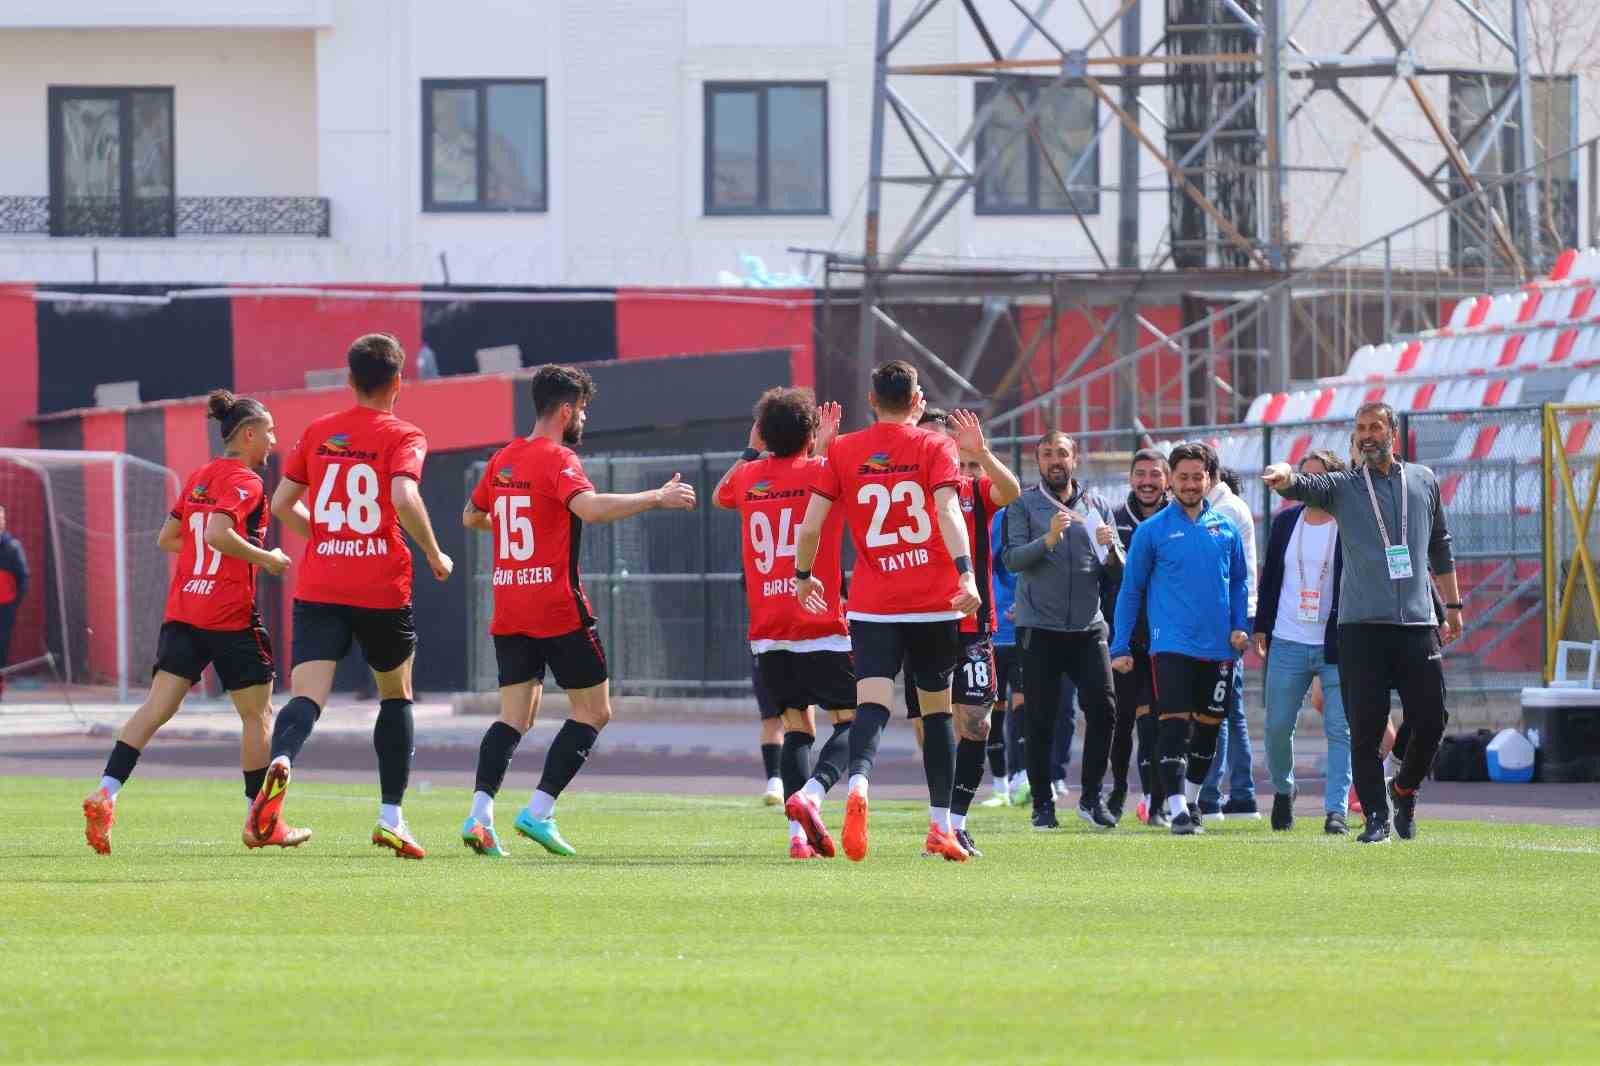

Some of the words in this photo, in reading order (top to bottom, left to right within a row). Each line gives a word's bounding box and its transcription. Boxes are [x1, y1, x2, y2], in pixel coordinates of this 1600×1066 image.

[314, 463, 382, 535] 48
[857, 480, 932, 548] 23
[494, 495, 535, 562] 15
[317, 538, 388, 557] ONURCAN
[750, 508, 800, 575] 94
[878, 548, 929, 572] TAYYIB
[182, 579, 217, 595] EMRE
[516, 566, 553, 586] GEZER
[963, 661, 989, 688] 18
[1213, 680, 1227, 702] 6
